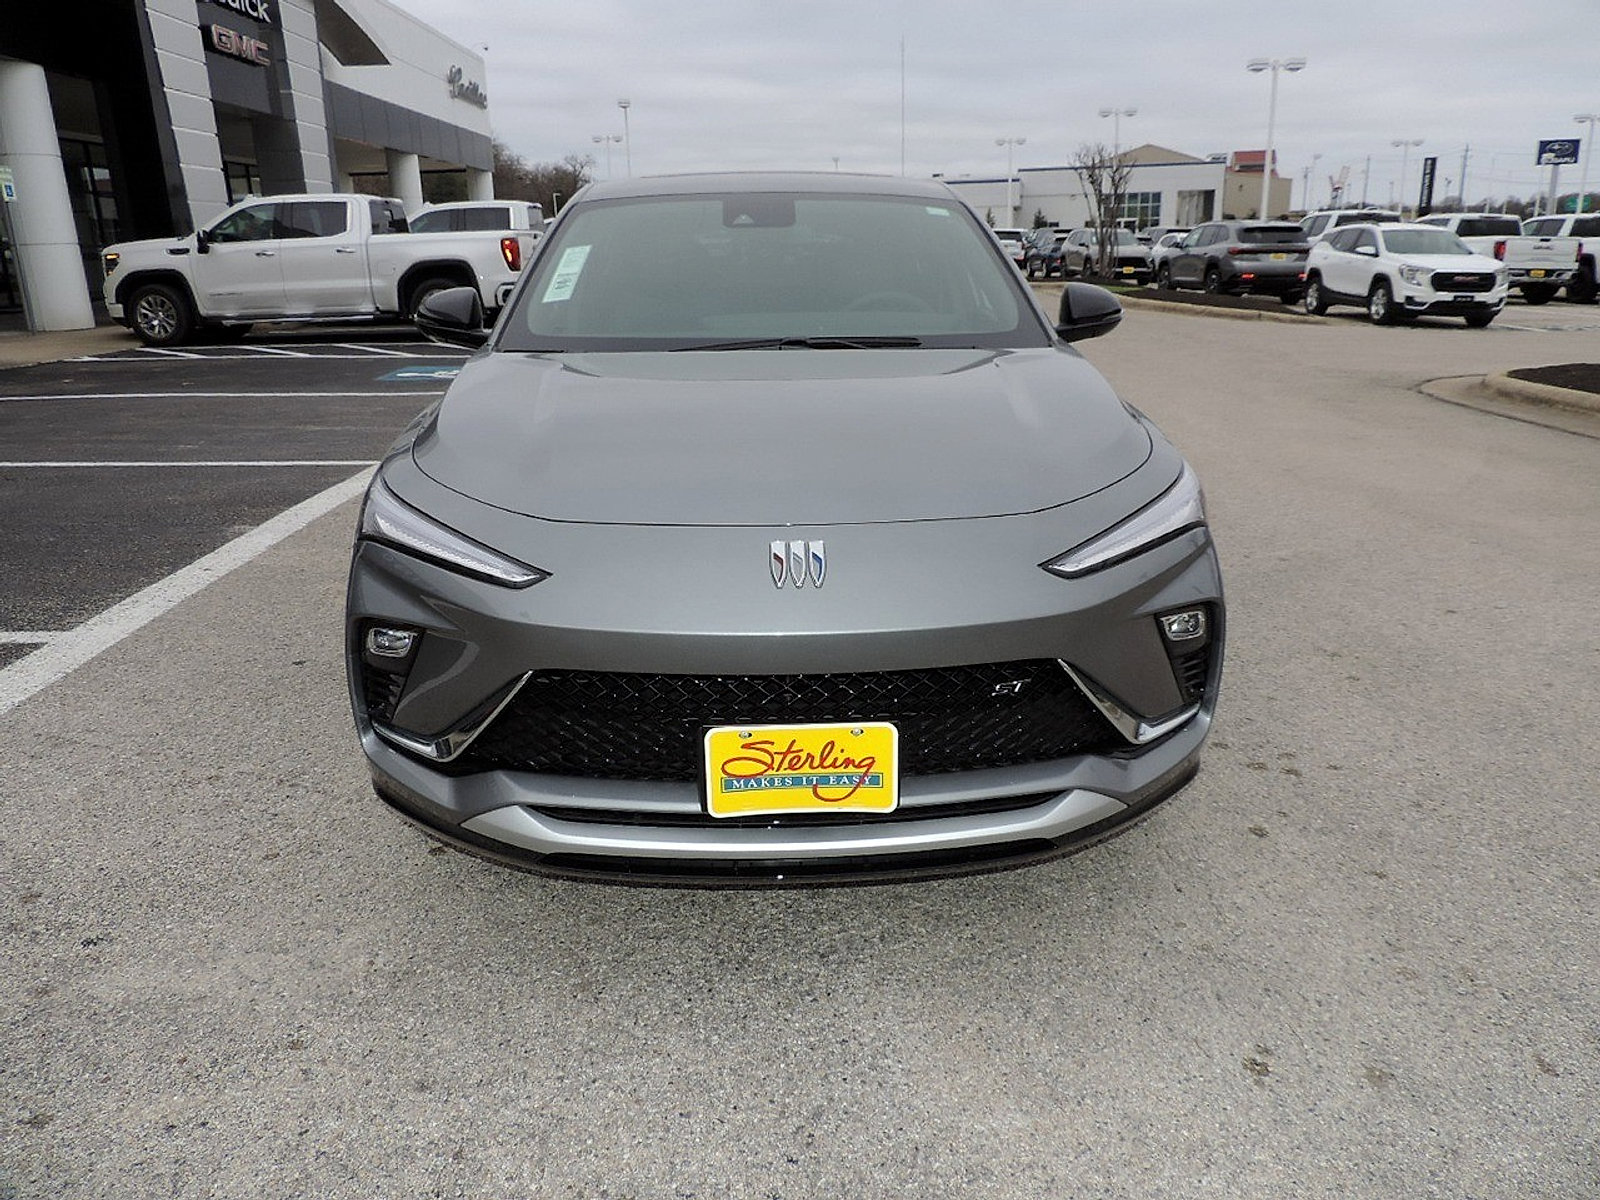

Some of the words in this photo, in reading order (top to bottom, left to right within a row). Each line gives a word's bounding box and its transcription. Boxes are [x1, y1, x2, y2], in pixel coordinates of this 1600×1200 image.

[220, 0, 271, 23] uick
[211, 23, 271, 67] GMC
[721, 739, 876, 802] Sterling
[732, 777, 793, 789] MAKES
[802, 775, 820, 787] IT
[829, 774, 872, 786] EASY
